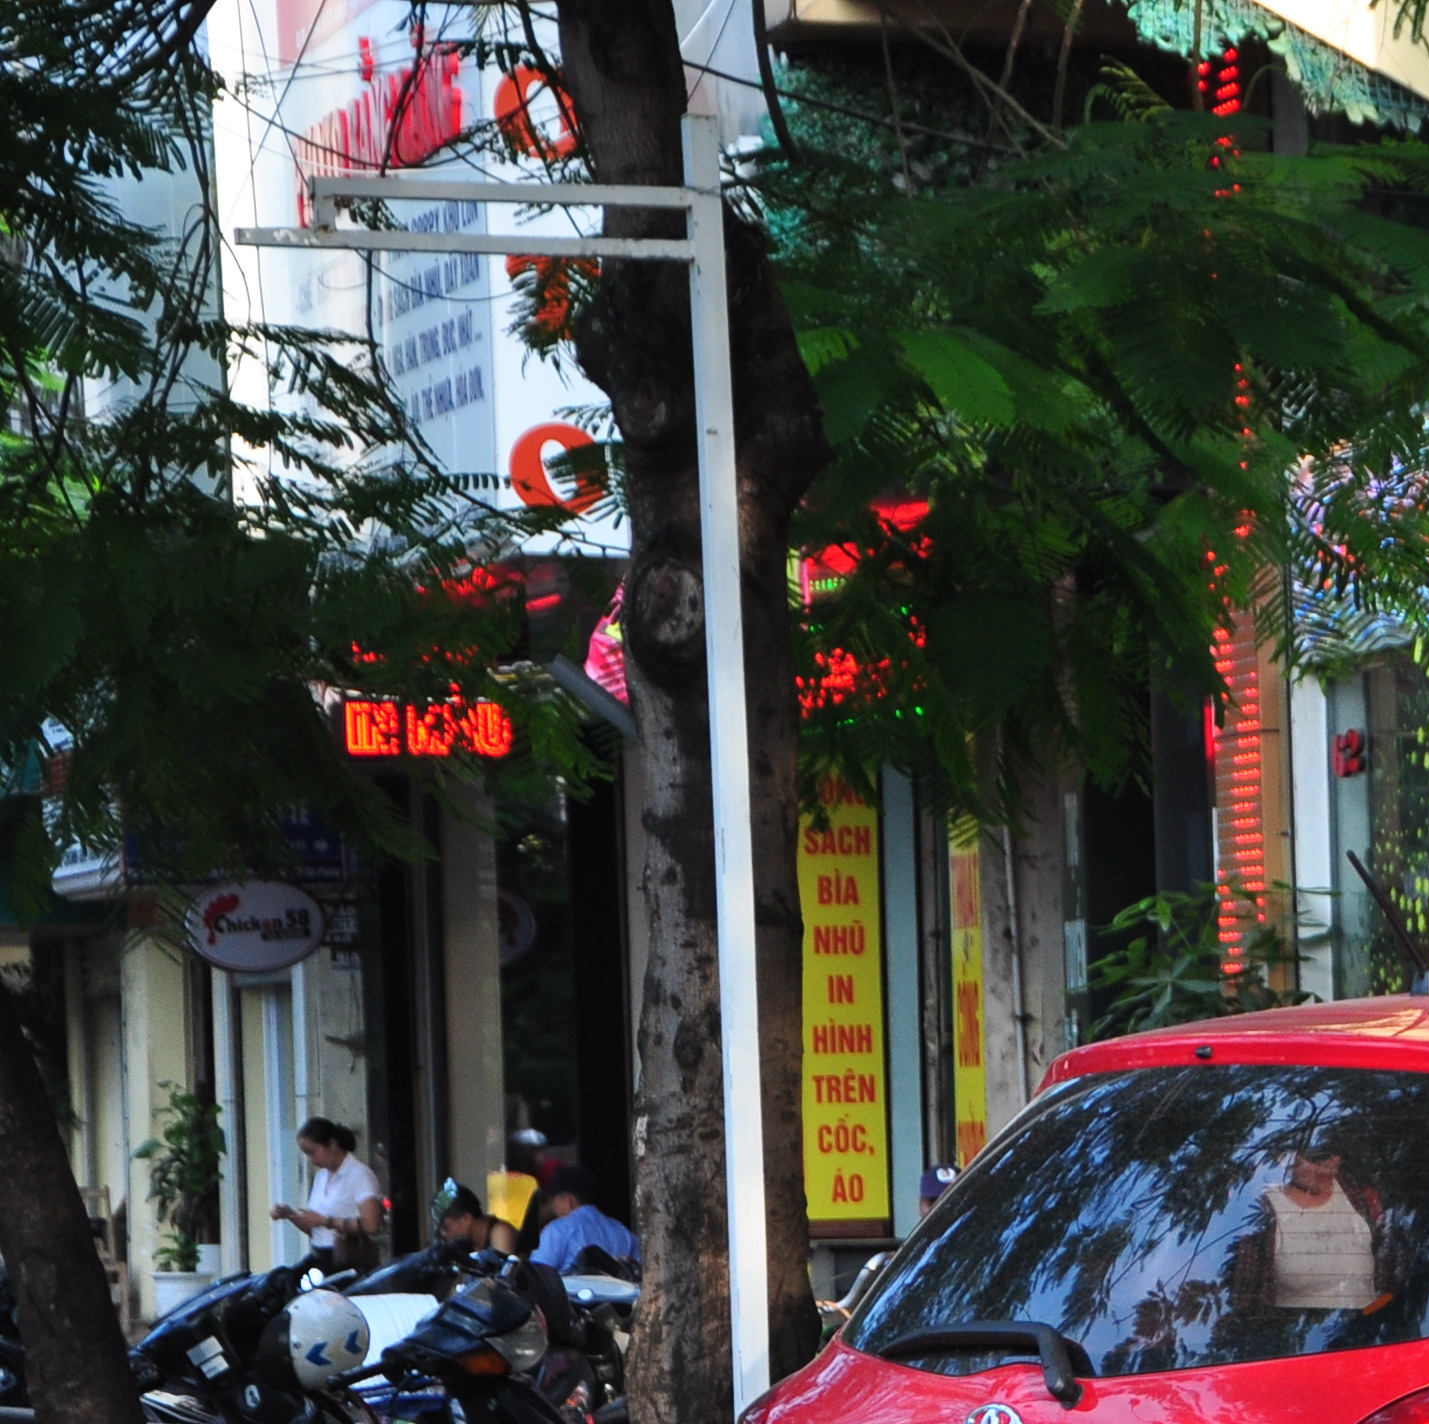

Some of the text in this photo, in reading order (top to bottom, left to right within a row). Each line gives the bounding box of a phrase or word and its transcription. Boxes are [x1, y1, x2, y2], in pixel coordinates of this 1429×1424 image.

[818, 868, 860, 906] BÌA
[814, 919, 866, 956] NHŨ
[828, 974, 855, 1004] IN
[813, 1018, 873, 1054] HÌNH
[812, 1068, 876, 1104] TRÊN
[832, 1168, 865, 1203] ÁO
